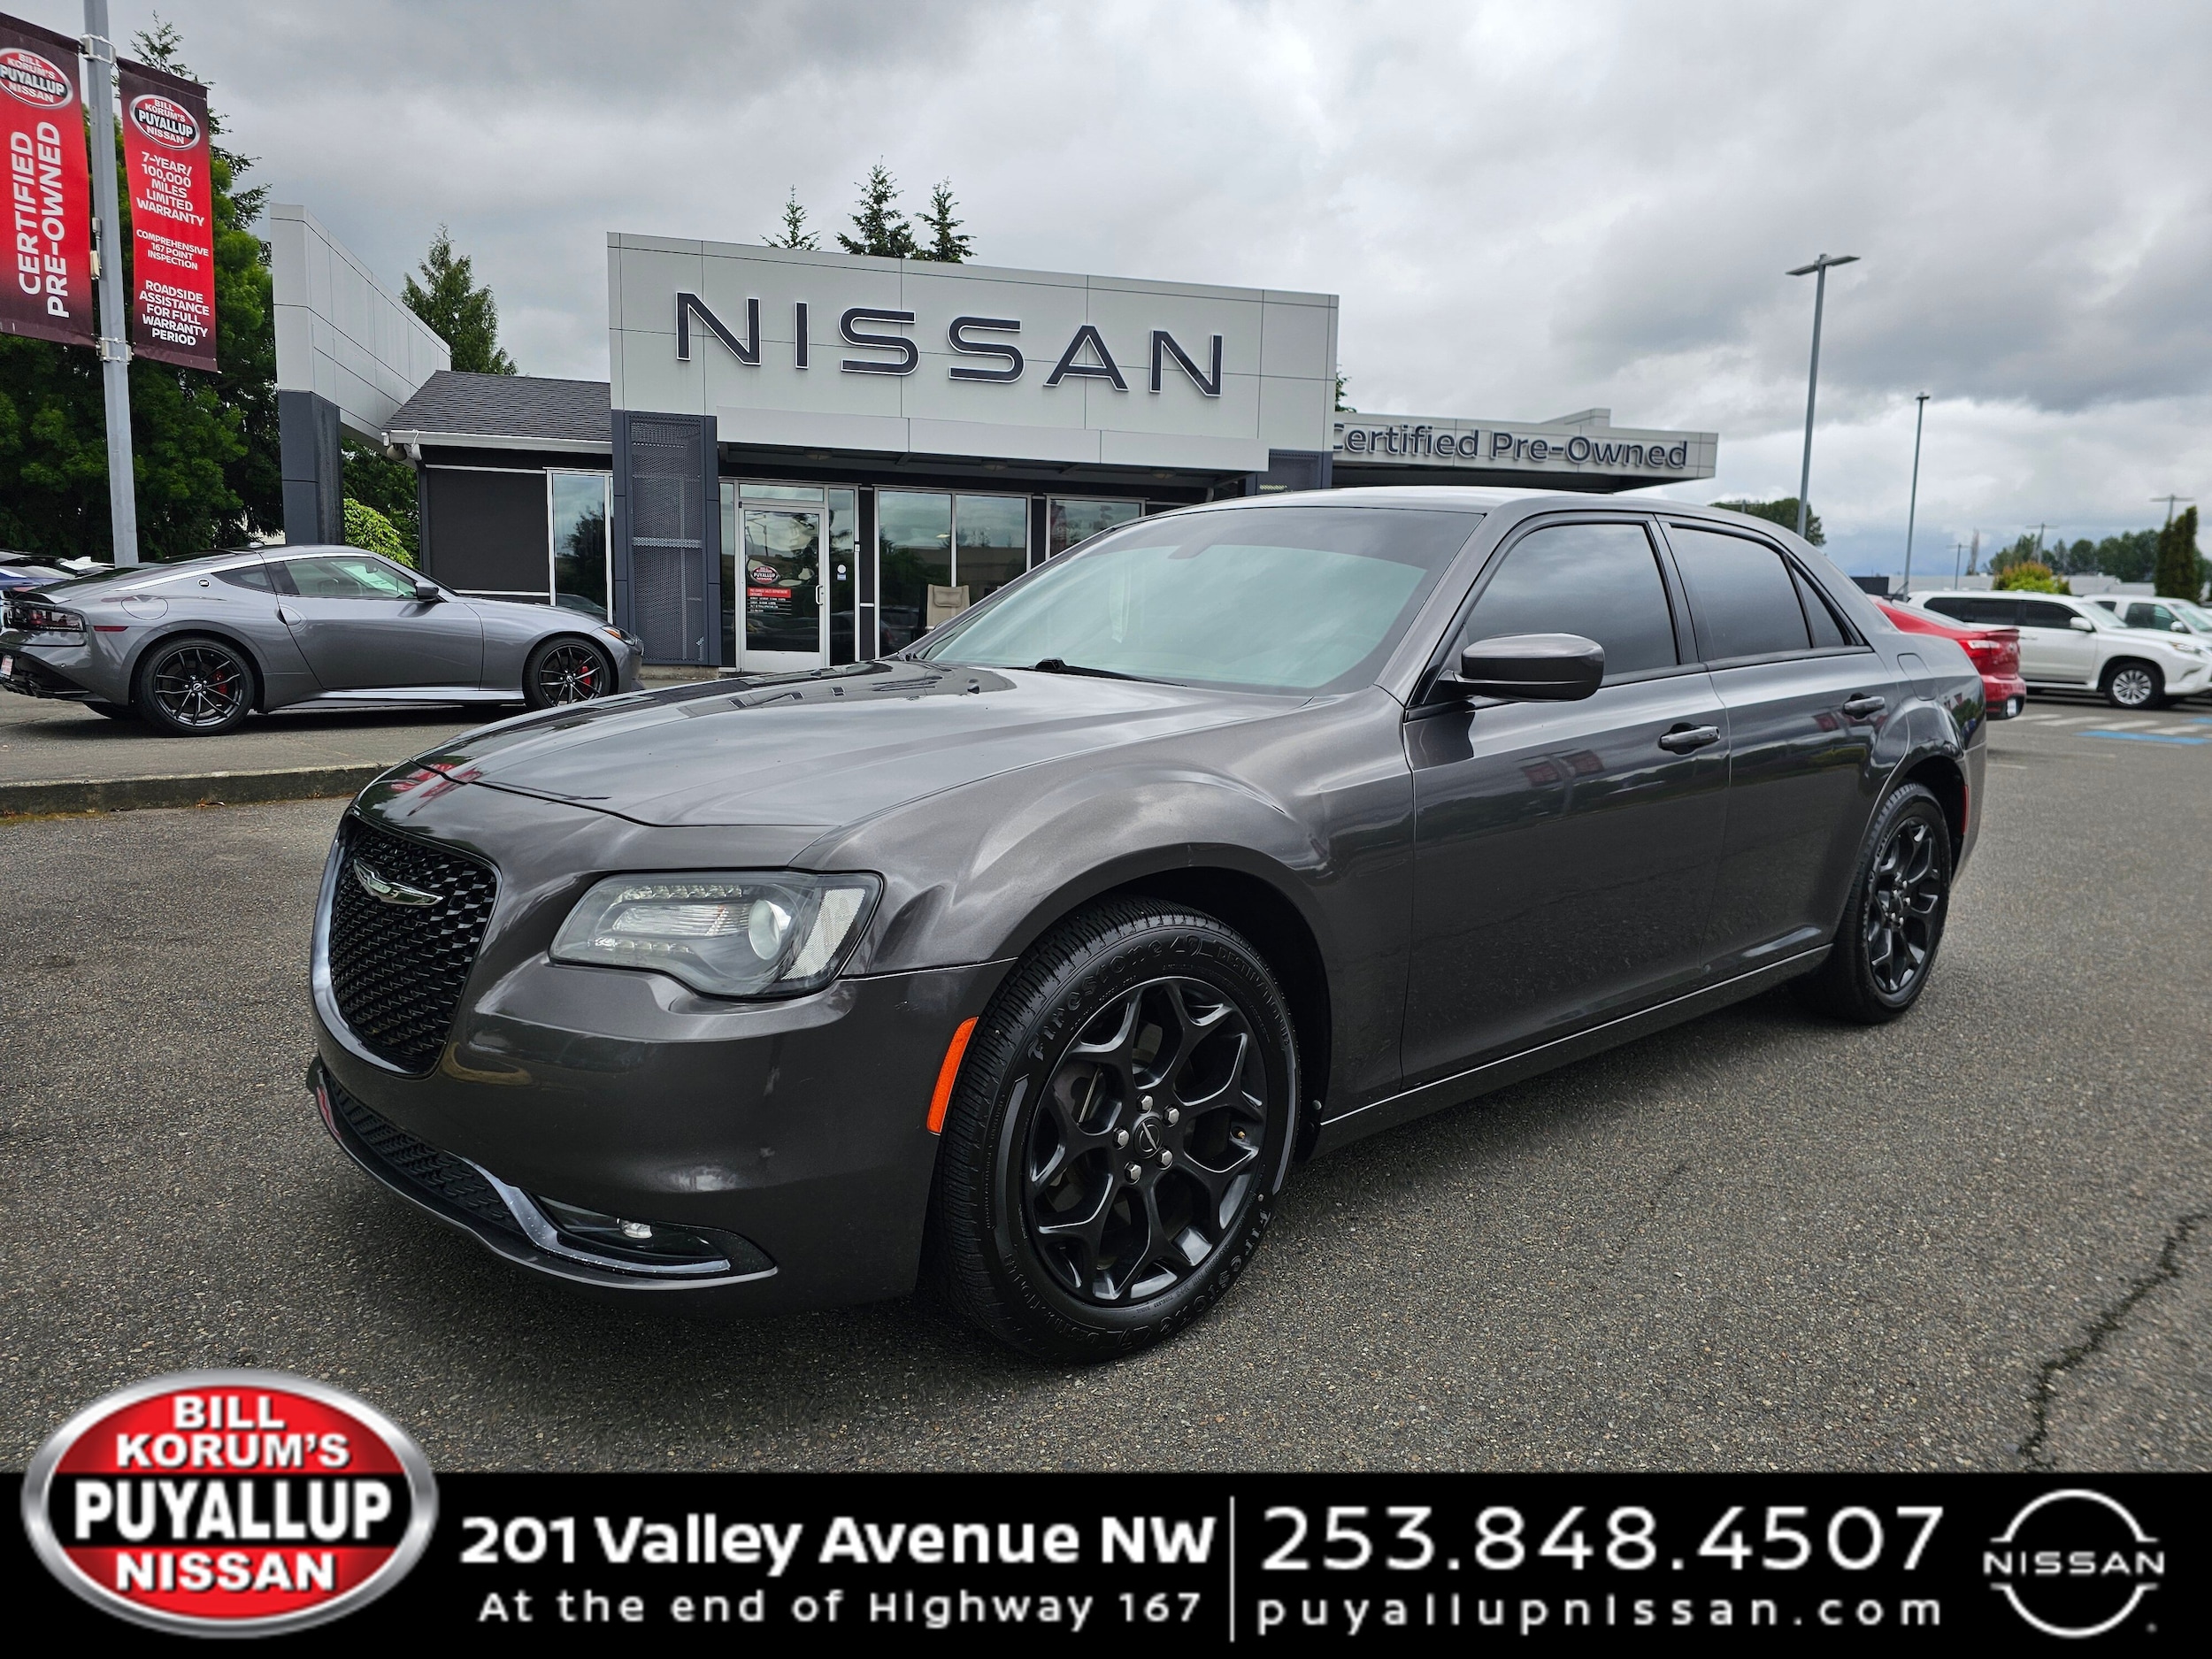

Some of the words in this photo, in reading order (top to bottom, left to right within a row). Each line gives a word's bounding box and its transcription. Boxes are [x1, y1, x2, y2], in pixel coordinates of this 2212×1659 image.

[7, 57, 56, 79] KORUM'S
[19, 53, 42, 68] BILL
[0, 65, 65, 96] PUYALLUP
[9, 81, 54, 103] NISSAN
[145, 103, 186, 122] KORUM'S
[154, 99, 174, 112] BILL
[138, 110, 193, 137] PUYALLUP
[147, 126, 184, 144] NISSAN
[142, 151, 192, 176] 7-YEAR/
[142, 164, 191, 188] 100,000
[146, 188, 193, 211] LIMITED
[151, 179, 188, 198] MILES
[11, 132, 41, 295] CERTIFIED
[37, 121, 69, 318] PRE-OWNED
[136, 197, 204, 227] WARRANTY
[136, 229, 209, 257] COMPREHENSIVE
[151, 242, 165, 253] 167
[166, 247, 194, 260] POINT
[148, 250, 198, 270] INSPECTION
[139, 290, 210, 316] ASSISTANCE
[145, 280, 204, 303] ROADSIDE
[142, 313, 208, 337] WARRANTY
[147, 303, 170, 318] FOR
[172, 310, 201, 325] FULL
[152, 327, 196, 346] PERIOD
[675, 291, 1224, 398] NISSAN
[1491, 431, 1688, 470] Pre-Owned
